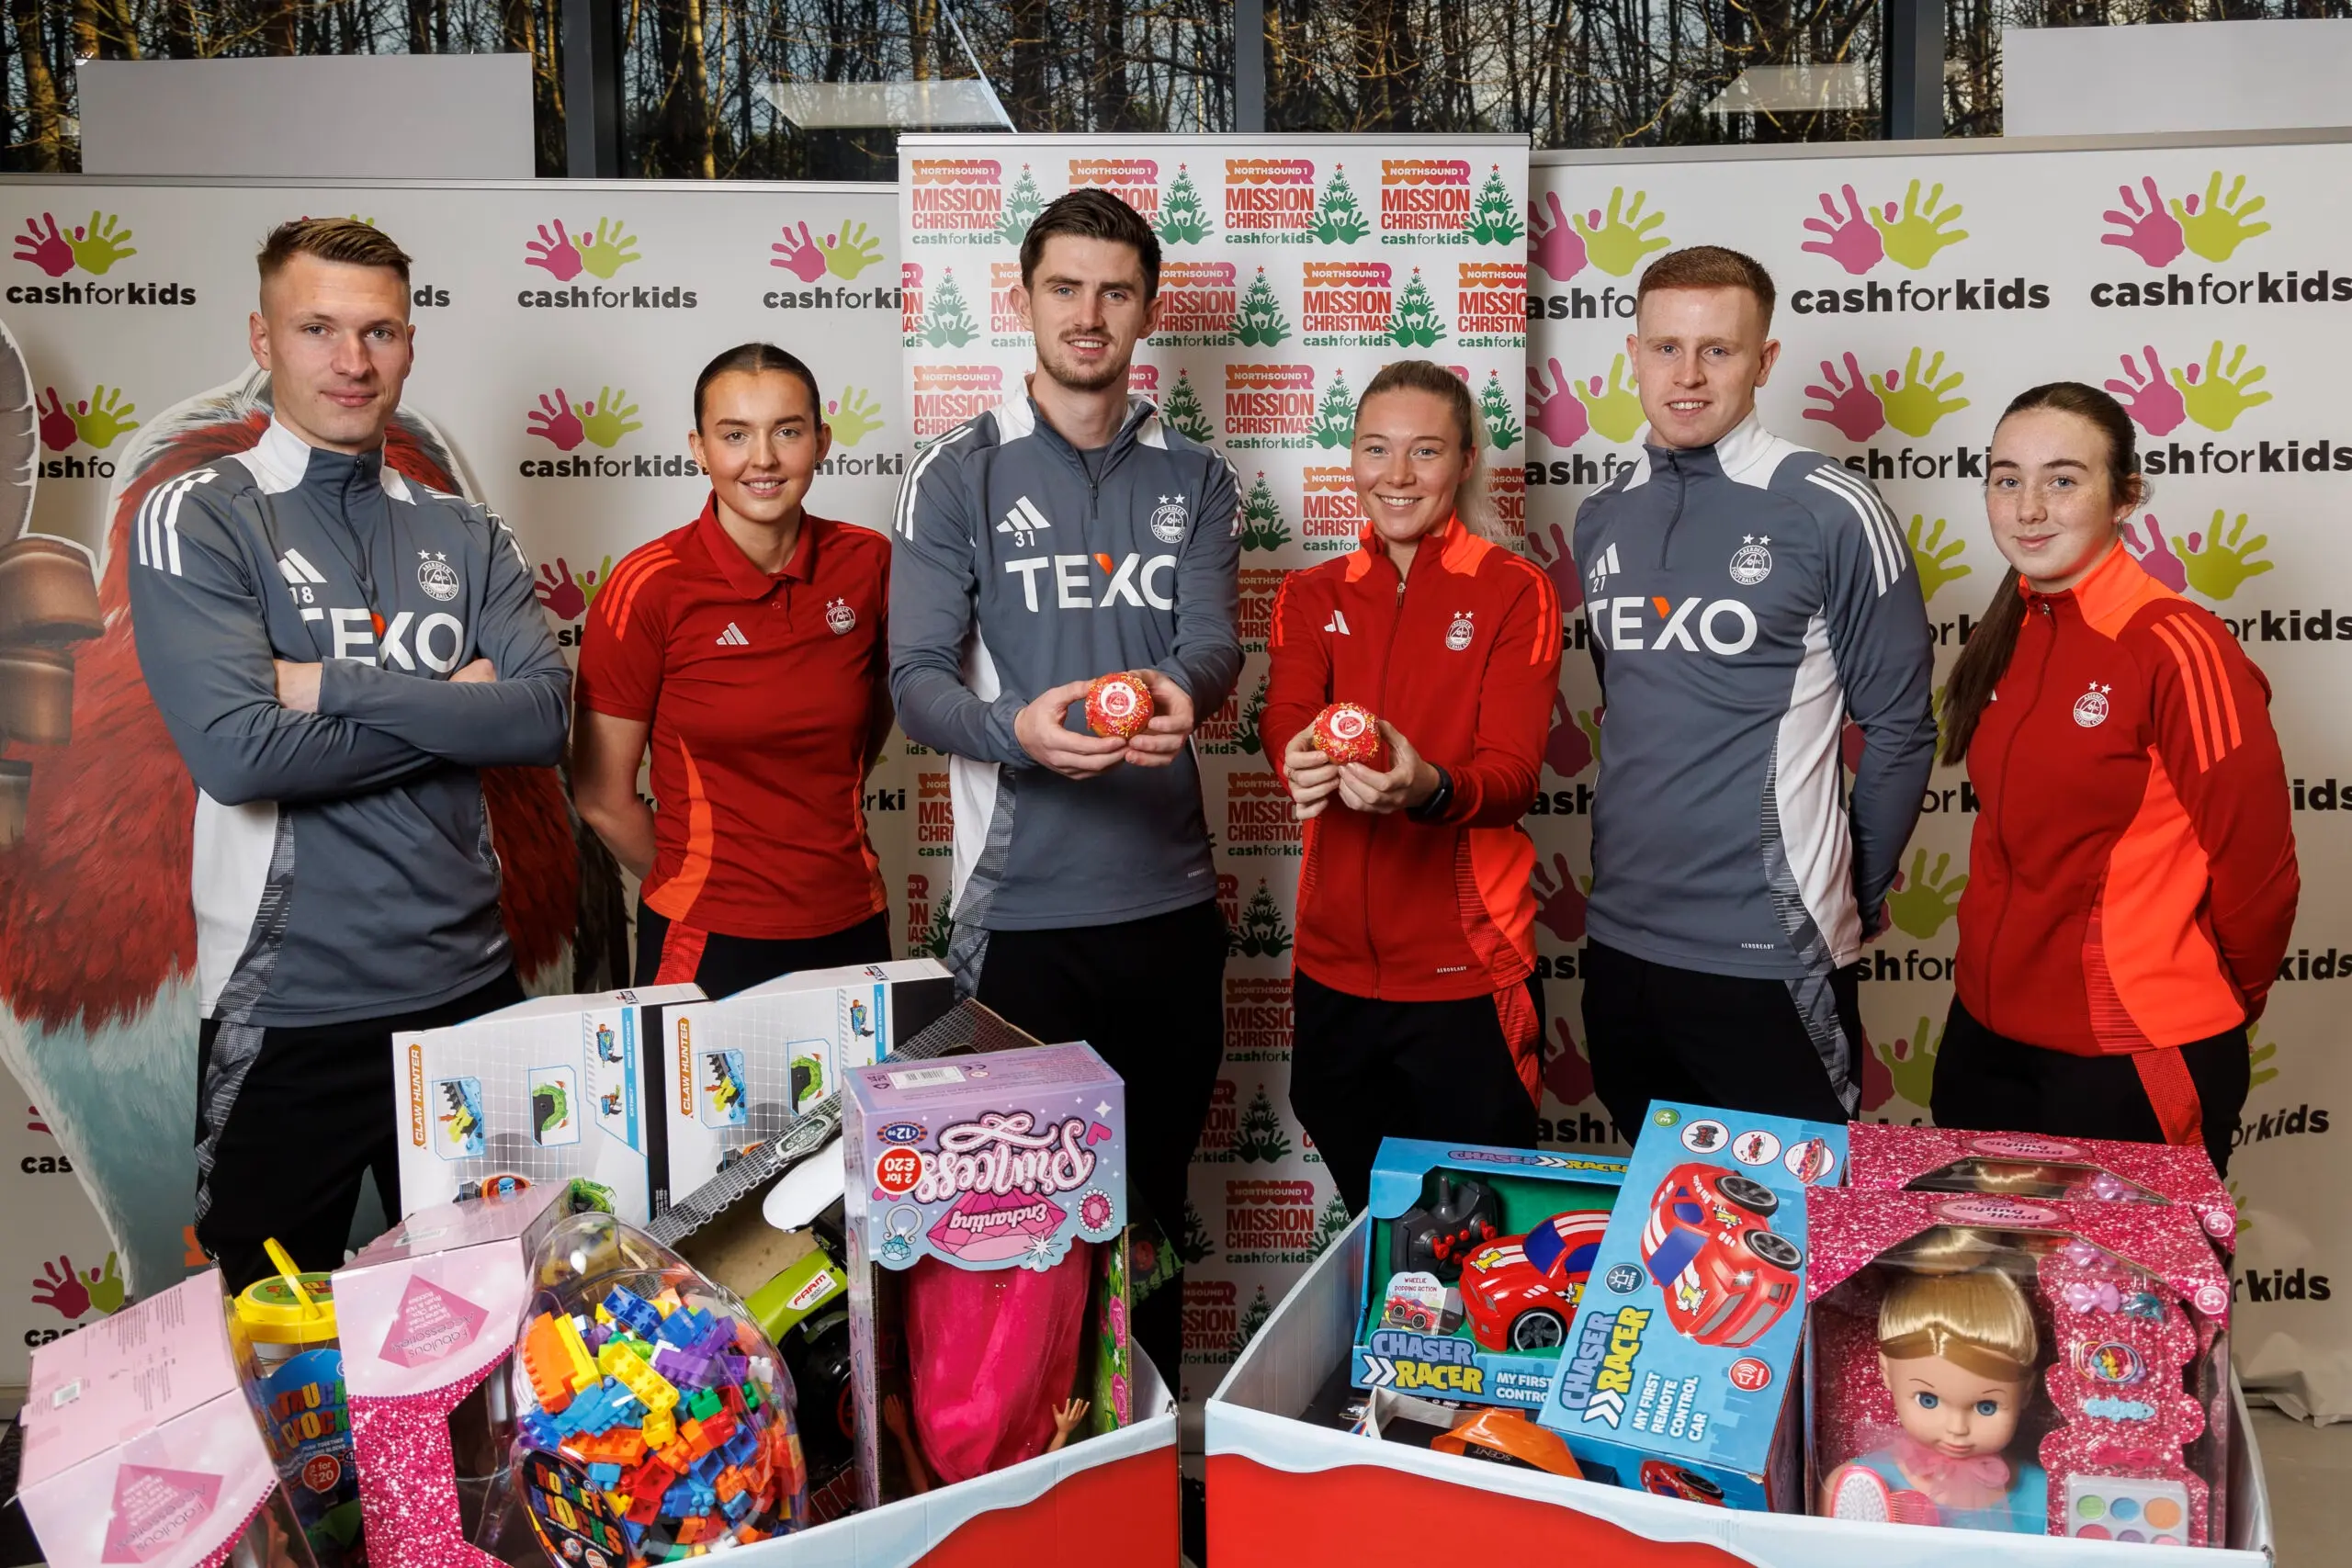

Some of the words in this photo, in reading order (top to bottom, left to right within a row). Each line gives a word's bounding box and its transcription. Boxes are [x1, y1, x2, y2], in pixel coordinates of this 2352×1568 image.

[912, 188, 1001, 211] MISSION
[1226, 188, 1314, 211] MISSION
[1382, 188, 1470, 211] MISSION
[911, 213, 1001, 230] CHRISTMAS
[1226, 212, 1314, 230] CHRISTMAS
[1381, 213, 1470, 230] CHRISTMAS
[912, 232, 1001, 244] cashforkids
[1226, 232, 1314, 244] cashforkids
[1382, 233, 1470, 244] cashforkids
[6, 282, 197, 305] cashforkids
[1791, 277, 2050, 314] cashforkids
[2091, 270, 2352, 307] cashforkids
[517, 287, 697, 309] cashforkids
[763, 287, 901, 309] cashforki
[1303, 291, 1391, 314] MISSION
[1459, 292, 1526, 314] MISSIO
[1159, 316, 1236, 332] HRISTMAS
[1303, 315, 1391, 332] CHRISTMAS
[1458, 316, 1526, 333] CHRISTM
[1147, 335, 1236, 347] cashforkids
[1303, 335, 1391, 347] cashforkids
[1458, 336, 1526, 348] cashforki
[922, 373, 989, 381] NORTHSOUND
[991, 373, 996, 381] 1
[1234, 372, 1301, 380] NORTHSOUND
[1303, 372, 1308, 380] 1
[1226, 393, 1314, 417] MISSION
[1226, 417, 1314, 434] CHRISTMAS
[1226, 437, 1314, 449] cashforkids
[520, 456, 698, 478] cashforkids
[1158, 506, 1185, 516] ABERDEEN
[1014, 531, 1036, 547] 31
[1303, 540, 1359, 551] cashfor
[1738, 547, 1768, 558] ABERDEEN
[423, 562, 450, 574] ABERDEEN
[1005, 553, 1177, 612] TEXO
[1593, 576, 1606, 593] 21
[289, 586, 314, 604] 18
[1588, 597, 1758, 656] TEXO
[1227, 801, 1299, 824] MISSIO
[1227, 825, 1303, 841] CHRISTMA
[1437, 965, 1467, 974] AEROREADY
[1226, 1031, 1294, 1047] CHRISTM
[679, 1021, 689, 1076] HUNTER
[1226, 1051, 1291, 1062] cashfork
[411, 1050, 421, 1102] HUNTER
[682, 1077, 691, 1111] CLAW
[413, 1105, 423, 1141] CLAW
[1659, 1112, 1672, 1123] 3+
[884, 1157, 915, 1172] £20
[1448, 1150, 1539, 1165] CHASER
[885, 1172, 902, 1183] for
[905, 1173, 913, 1183] 2
[948, 1203, 1047, 1233] Enchanting
[1226, 1209, 1314, 1232] MISSION
[2209, 1217, 2227, 1230] 5+
[1226, 1232, 1314, 1248] CHRISTMAS
[1226, 1251, 1314, 1264] cashforkids
[793, 1273, 827, 1306] FARM
[1626, 1271, 1637, 1291] LIGHTS
[2201, 1293, 2222, 1306] 5+
[410, 1329, 467, 1358] Fabulous
[1371, 1332, 1474, 1364] CHASER
[1597, 1306, 1652, 1393] RACER
[1561, 1311, 1616, 1409] CHASER
[1395, 1361, 1484, 1393] RACER
[1497, 1373, 1516, 1386] MY
[1755, 1367, 1765, 1388] SOUNDS
[1496, 1389, 1547, 1403] CONTRO
[1637, 1372, 1657, 1407] FIRST
[1652, 1379, 1678, 1434] REMOTE
[1668, 1376, 1700, 1438] CONTROL
[1633, 1409, 1646, 1430] MY
[1687, 1413, 1708, 1441] CAR
[1472, 1446, 1514, 1461] SCENT
[135, 1502, 204, 1552] Fabulous
[530, 1484, 624, 1555] BLOCKS
